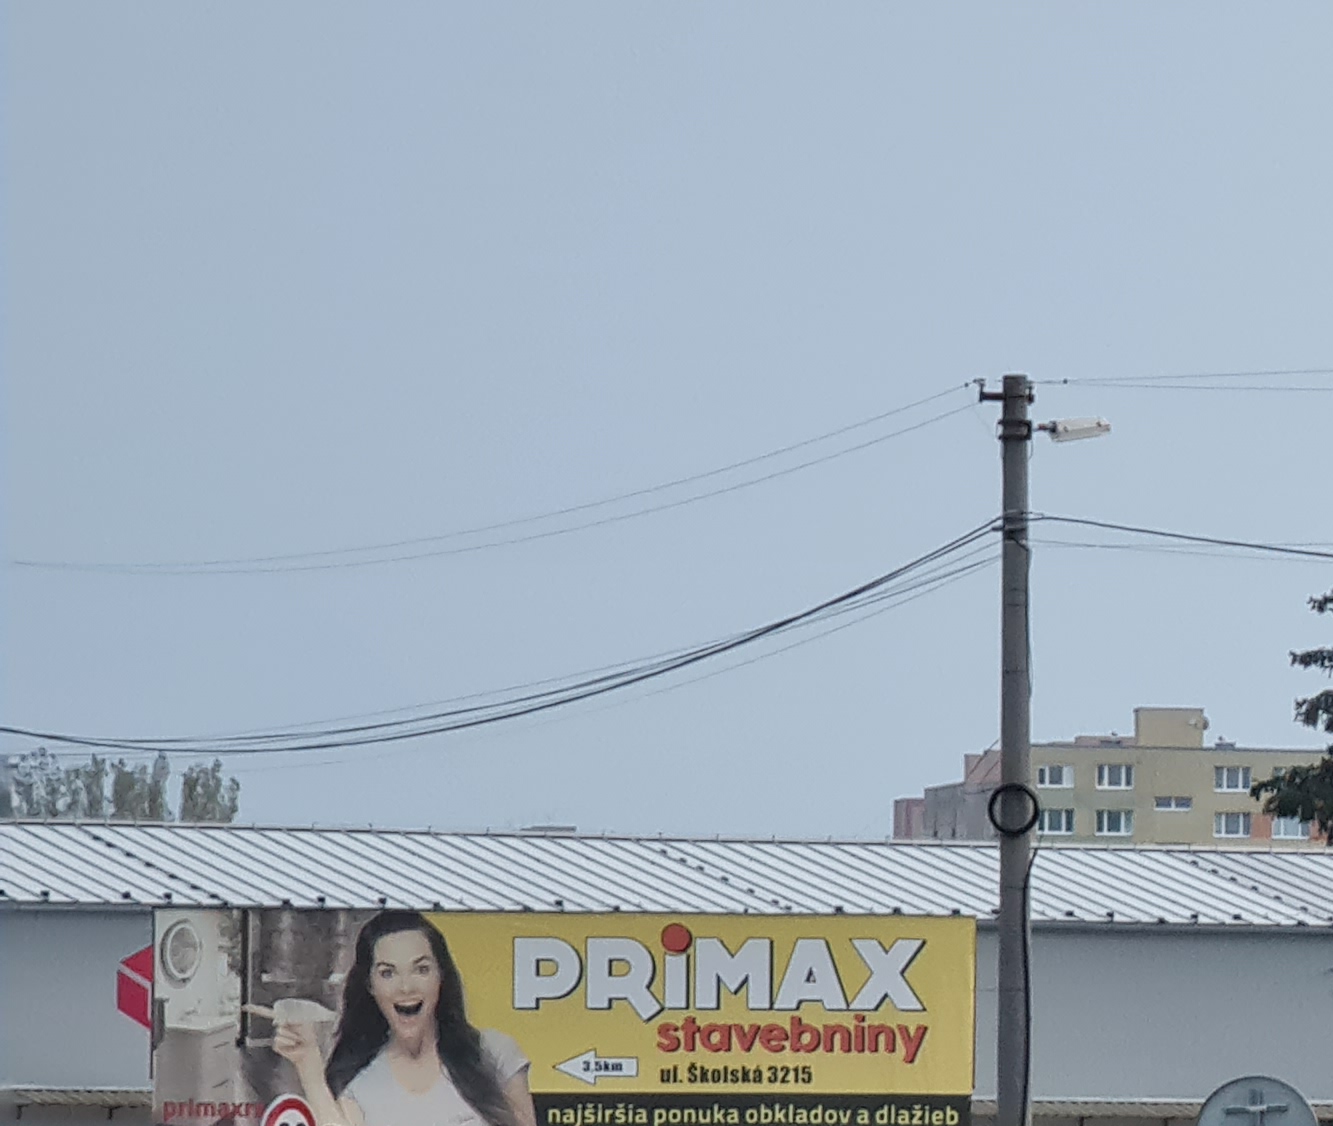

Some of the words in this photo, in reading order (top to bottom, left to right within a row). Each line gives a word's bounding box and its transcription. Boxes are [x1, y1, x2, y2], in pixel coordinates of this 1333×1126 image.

[656, 1014, 928, 1063] stavebniny
[660, 1067, 684, 1084] ul.
[687, 1063, 764, 1084] Školská
[767, 1066, 813, 1084] 3215
[547, 1103, 648, 1126] najširšia
[746, 1104, 851, 1126] obkladov
[856, 1110, 869, 1125] a
[875, 1103, 959, 1126] dlažieb
